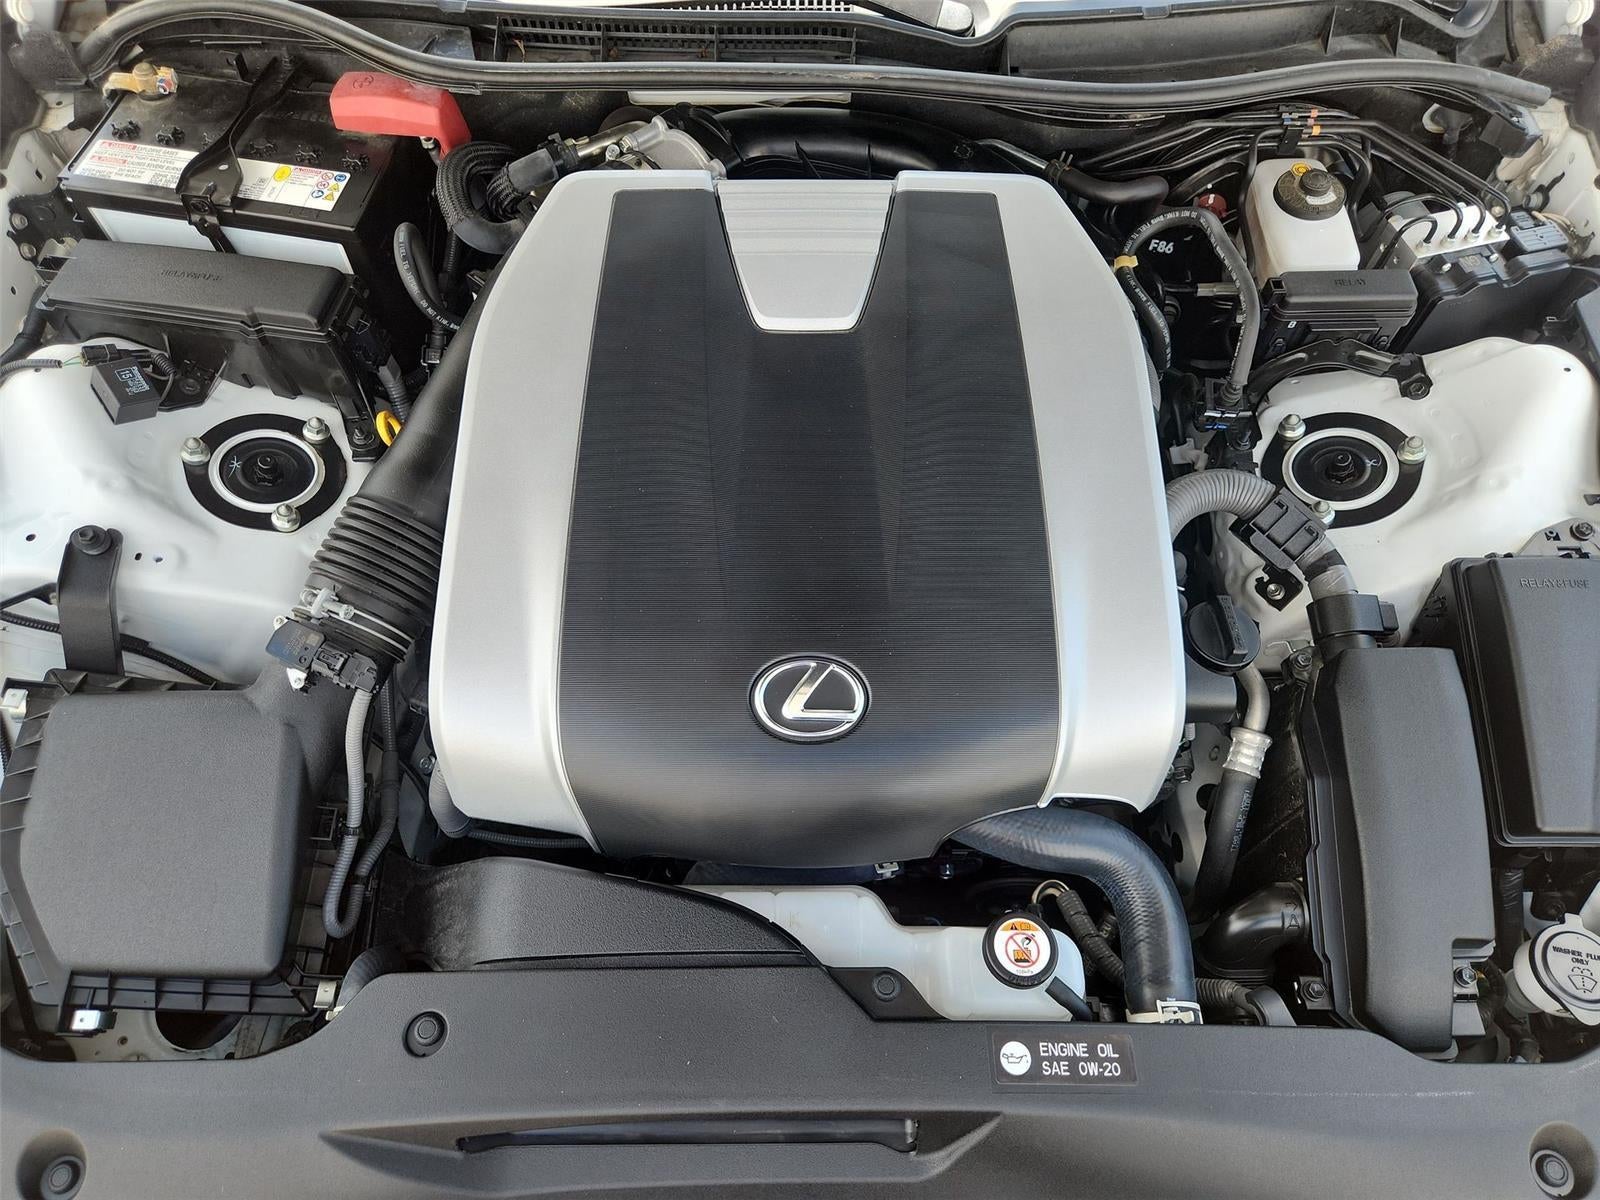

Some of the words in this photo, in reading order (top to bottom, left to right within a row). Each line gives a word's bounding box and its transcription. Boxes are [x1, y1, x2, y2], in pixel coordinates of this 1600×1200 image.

[1571, 957, 1590, 965] ONLY
[1039, 1042, 1089, 1057] ENGINE
[1097, 1043, 1120, 1058] OIL
[1042, 1061, 1071, 1076] SAE
[1078, 1061, 1121, 1076] 0W-20
